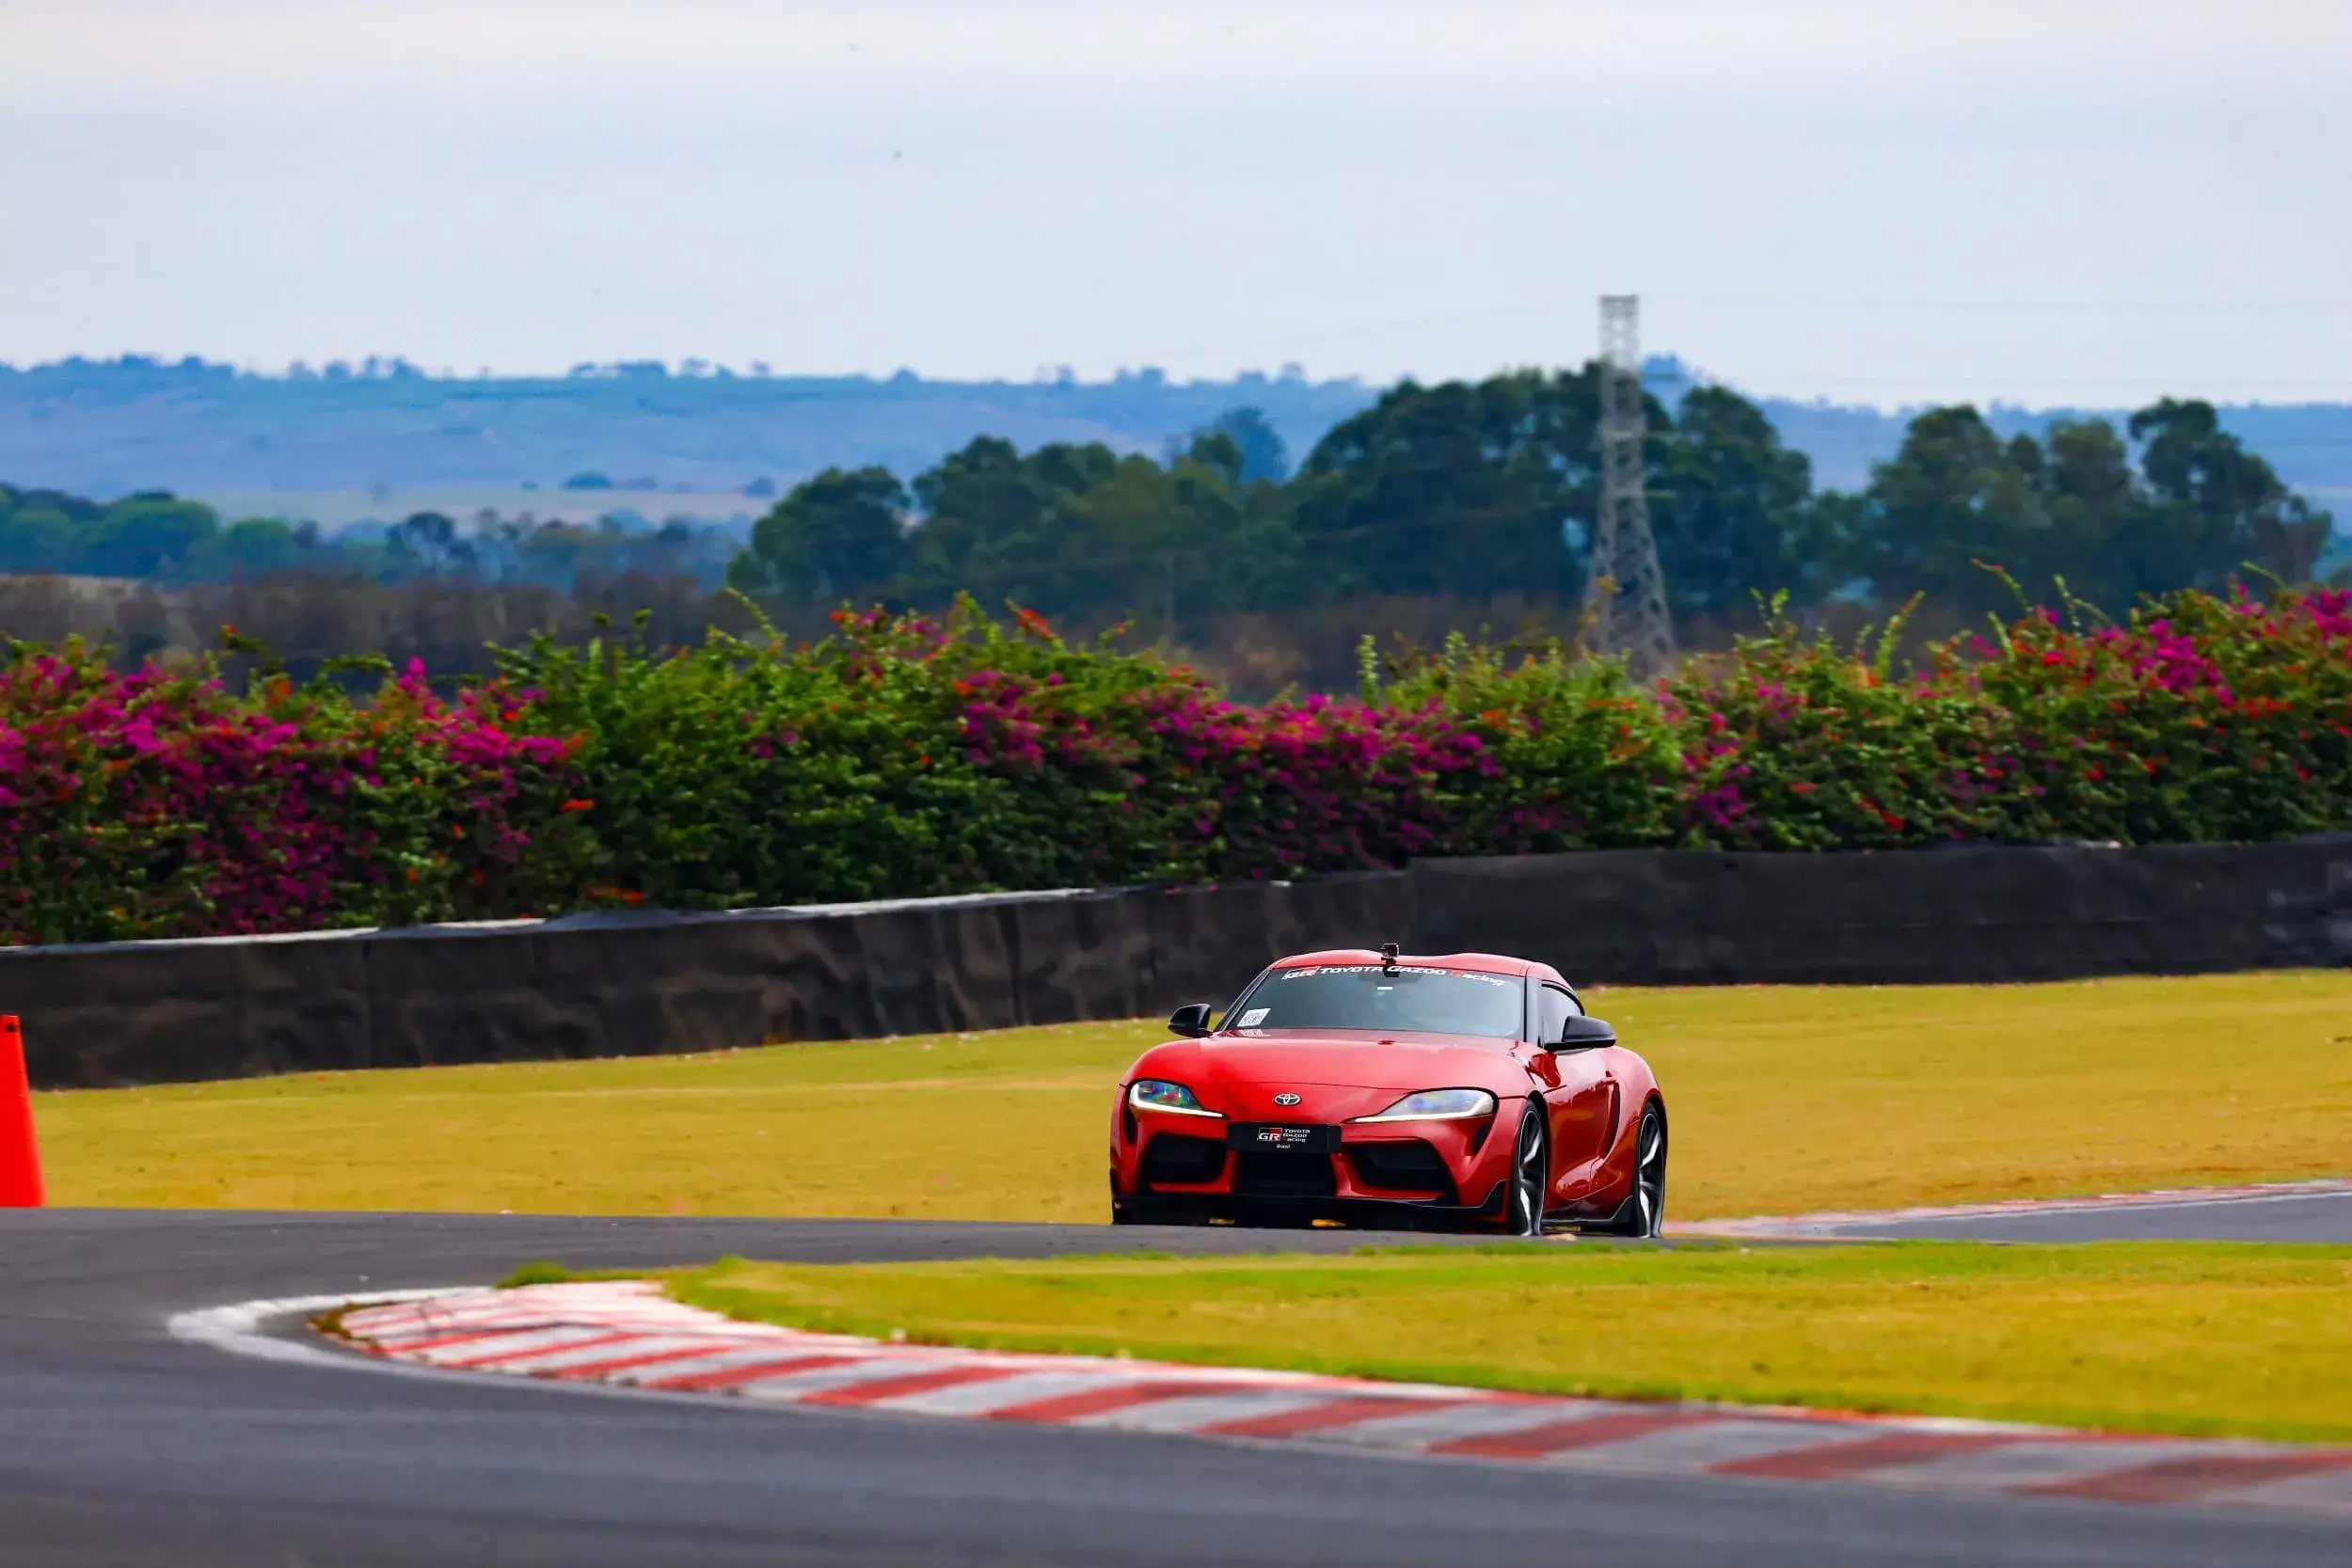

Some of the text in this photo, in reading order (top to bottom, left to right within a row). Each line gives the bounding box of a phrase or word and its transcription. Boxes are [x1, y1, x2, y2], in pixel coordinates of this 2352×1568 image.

[1282, 968, 1319, 979] GR
[1320, 966, 1383, 974] TOYOTA
[1387, 965, 1447, 975] GAZOO
[1258, 1132, 1280, 1141] GR
